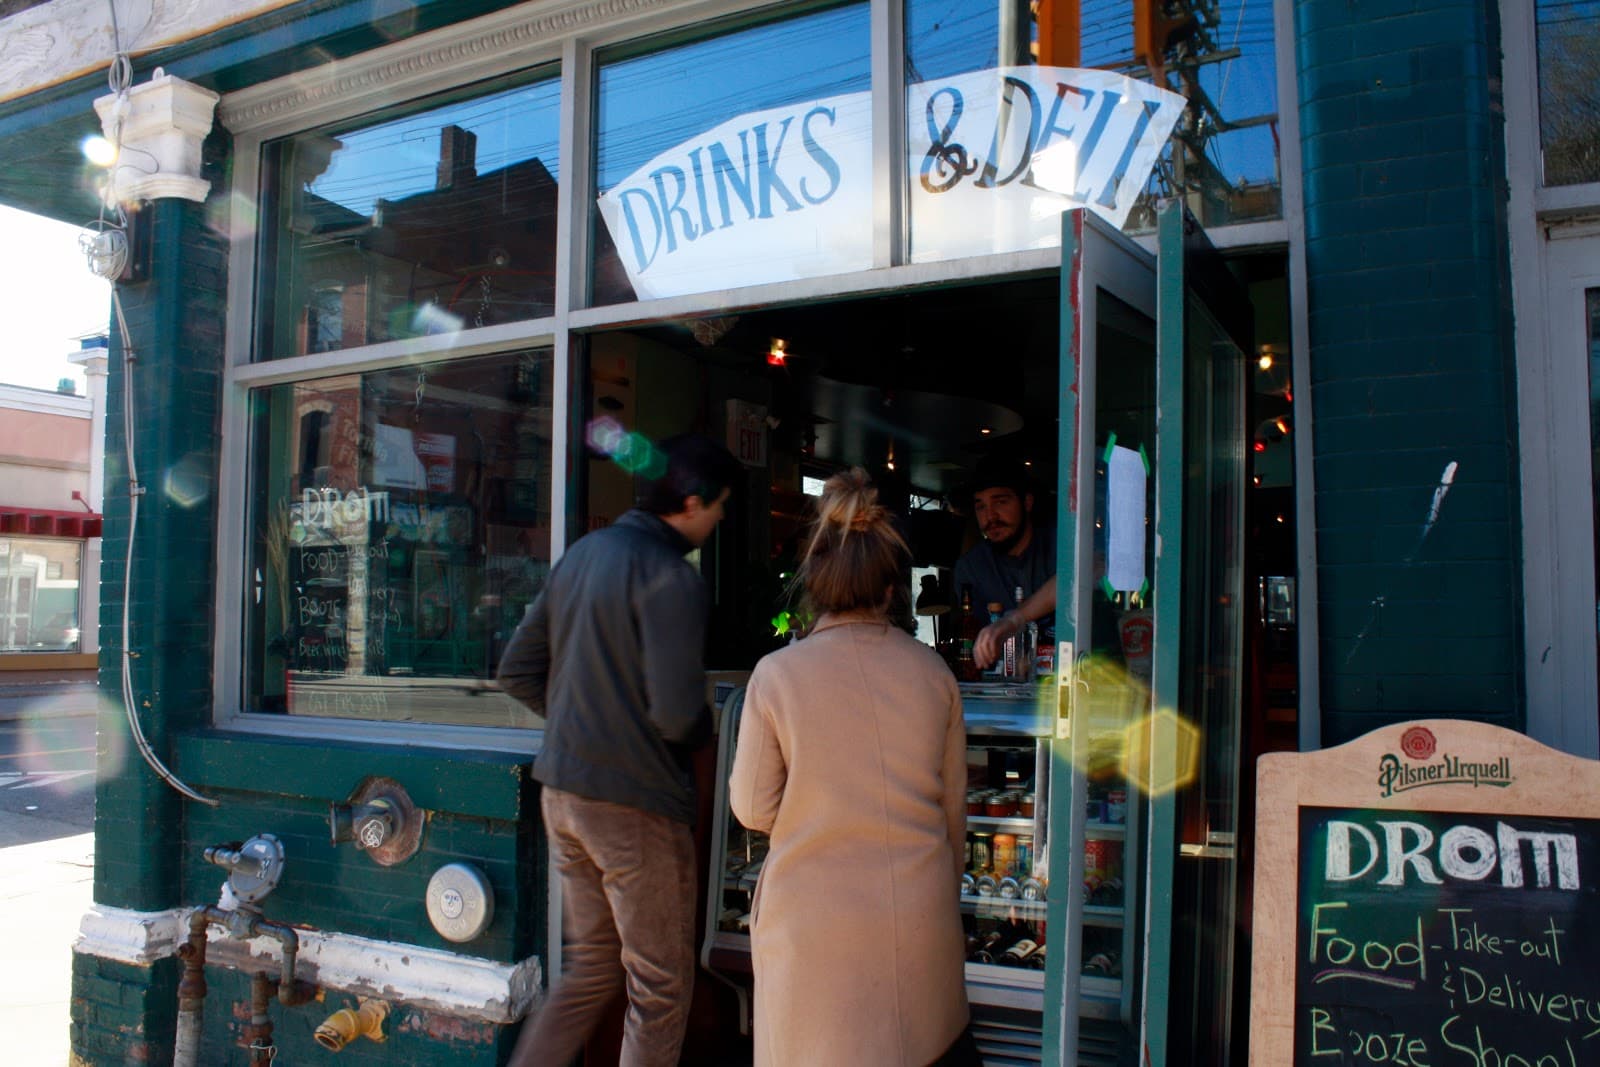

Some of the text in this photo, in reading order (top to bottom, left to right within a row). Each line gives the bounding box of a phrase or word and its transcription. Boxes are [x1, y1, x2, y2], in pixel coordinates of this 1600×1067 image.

[618, 76, 1161, 274] DRINKS & DELI
[1378, 753, 1510, 798] Pilsner Urquell
[1325, 820, 1580, 890] DROM
